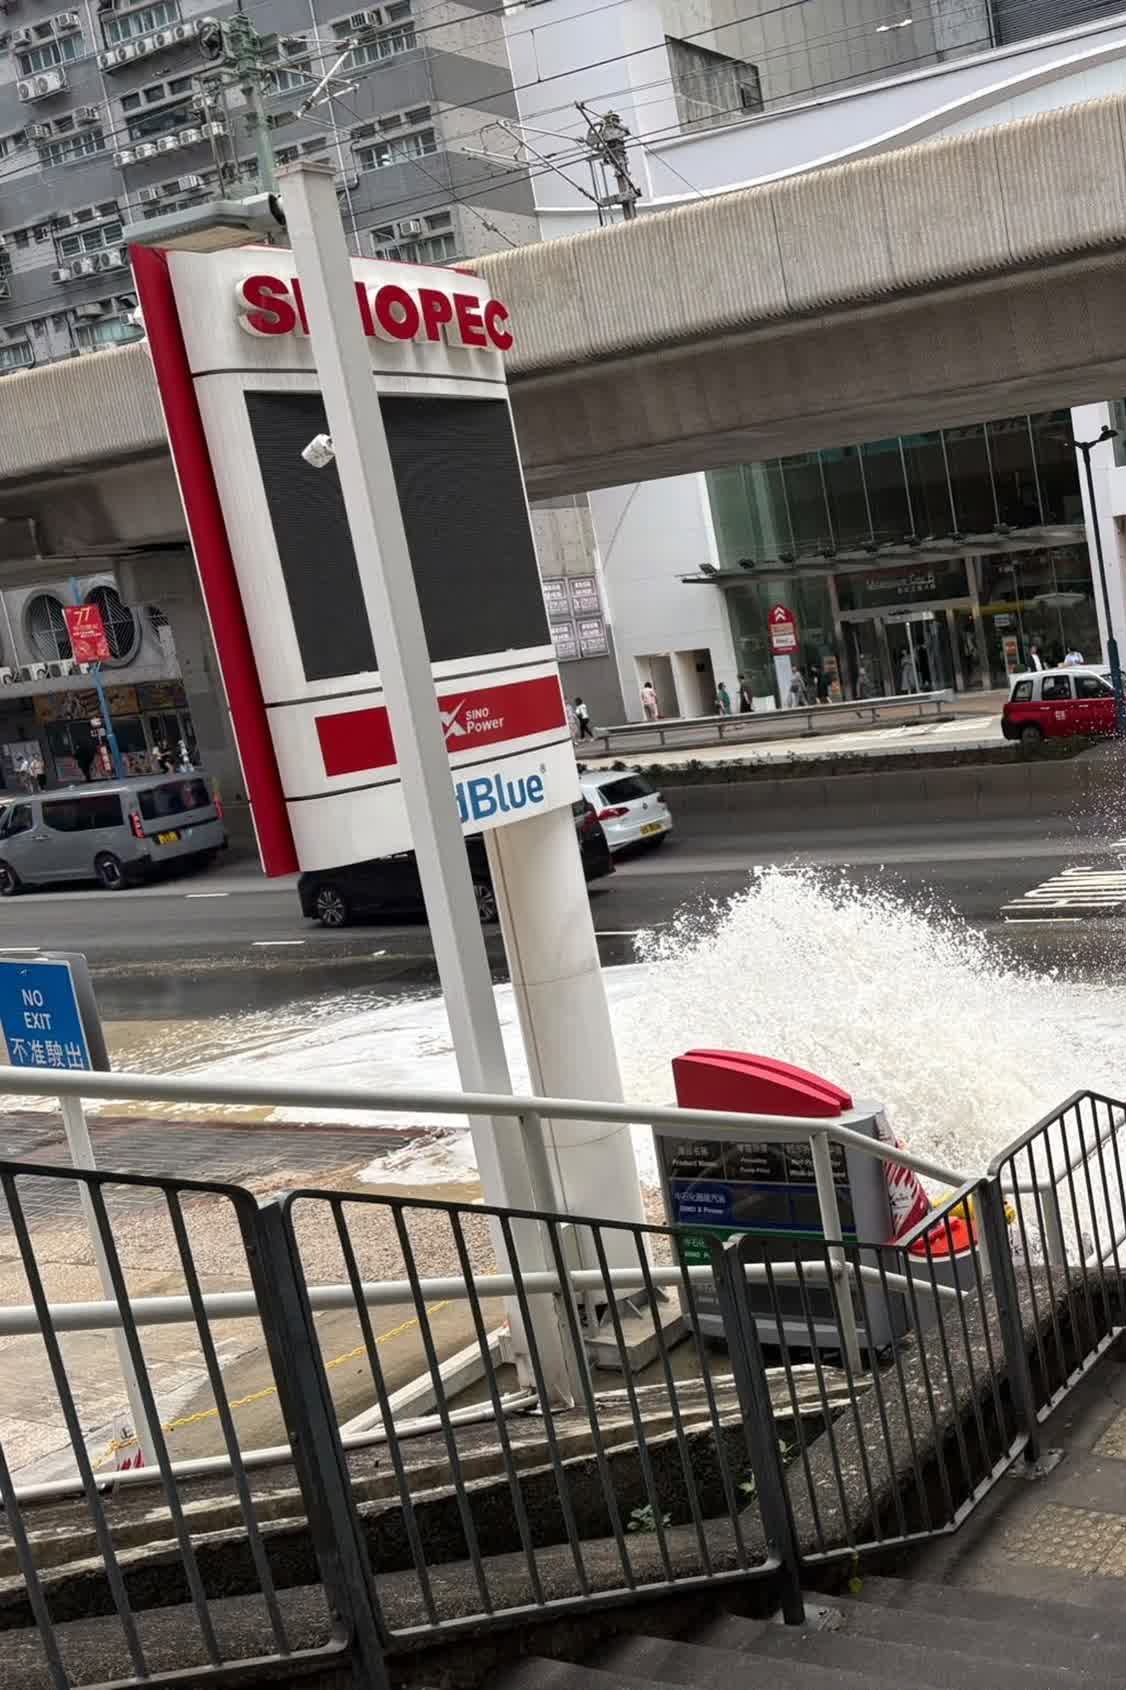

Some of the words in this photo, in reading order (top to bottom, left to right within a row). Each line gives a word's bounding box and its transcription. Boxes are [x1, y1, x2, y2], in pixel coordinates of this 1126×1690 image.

[465, 707, 489, 721] SINO
[466, 717, 504, 734] Power
[21, 988, 43, 1008] NO
[23, 1011, 51, 1031] EXIT
[10, 1037, 84, 1069] 不准駛出
